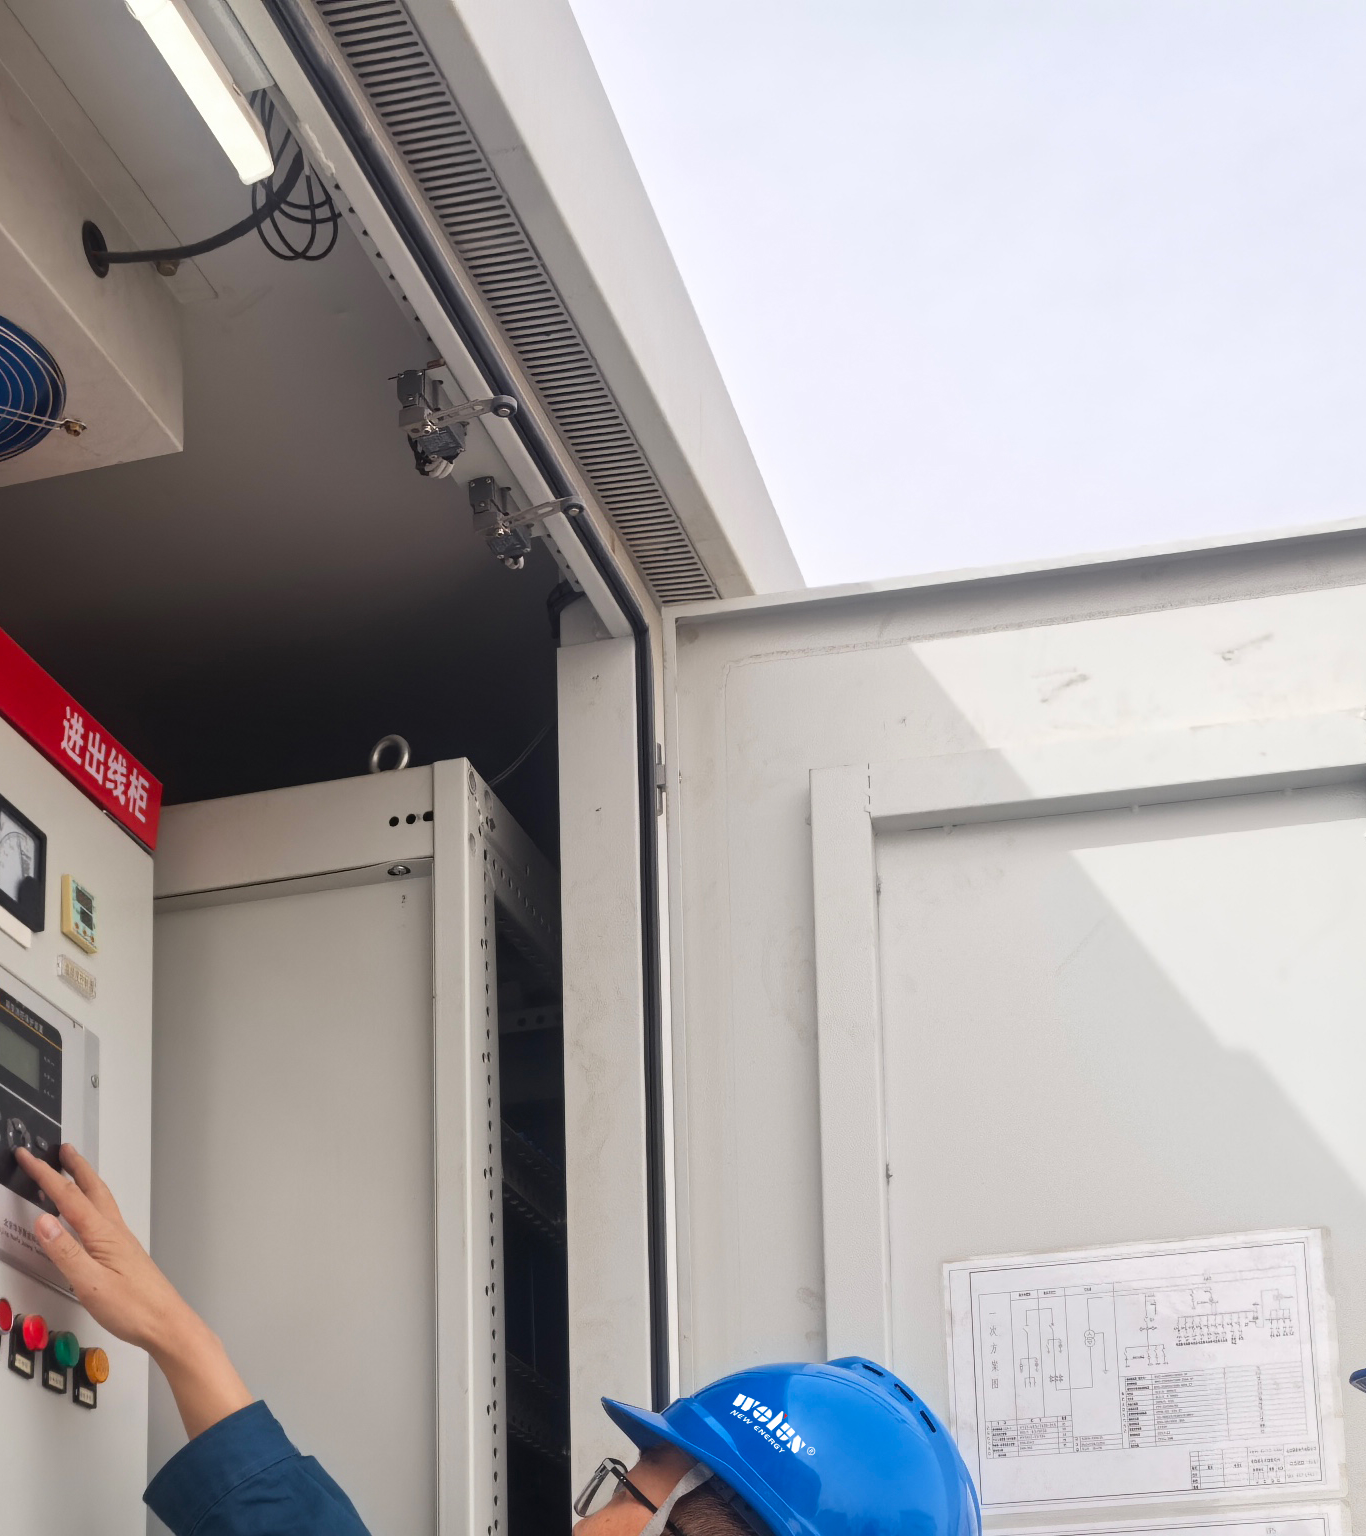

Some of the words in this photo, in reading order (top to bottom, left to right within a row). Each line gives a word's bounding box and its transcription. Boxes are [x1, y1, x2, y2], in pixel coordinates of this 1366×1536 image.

[61, 706, 150, 824] 进出线柜
[730, 1409, 753, 1425] NEW
[754, 1425, 786, 1454] ENERGY
